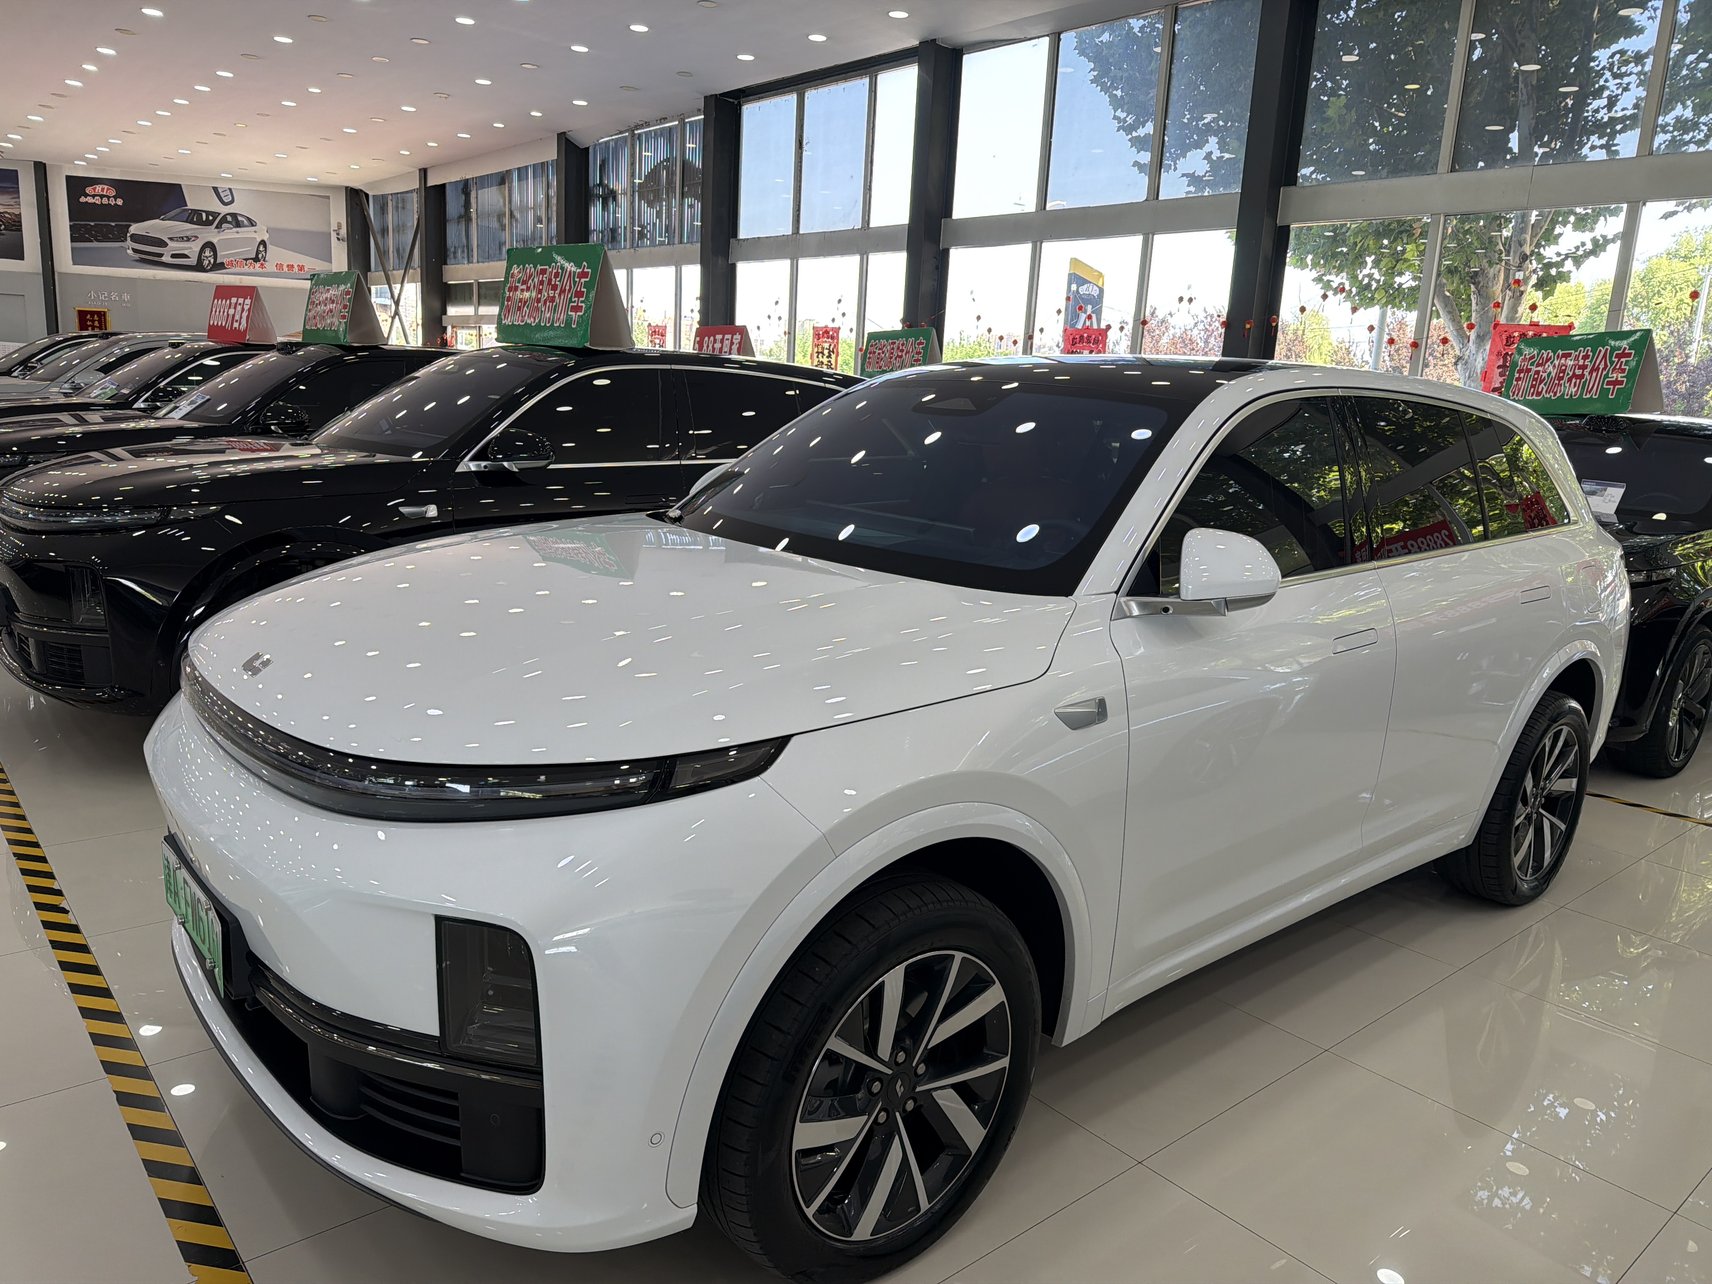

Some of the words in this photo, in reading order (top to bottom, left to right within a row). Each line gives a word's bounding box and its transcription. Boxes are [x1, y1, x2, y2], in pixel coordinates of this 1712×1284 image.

[224, 259, 267, 271] 诚信为本
[275, 262, 317, 273] 信誉第一
[502, 262, 591, 328] 新能源特价车
[865, 337, 926, 372] 新能源特价车
[1509, 345, 1635, 400] 新能源特价车
